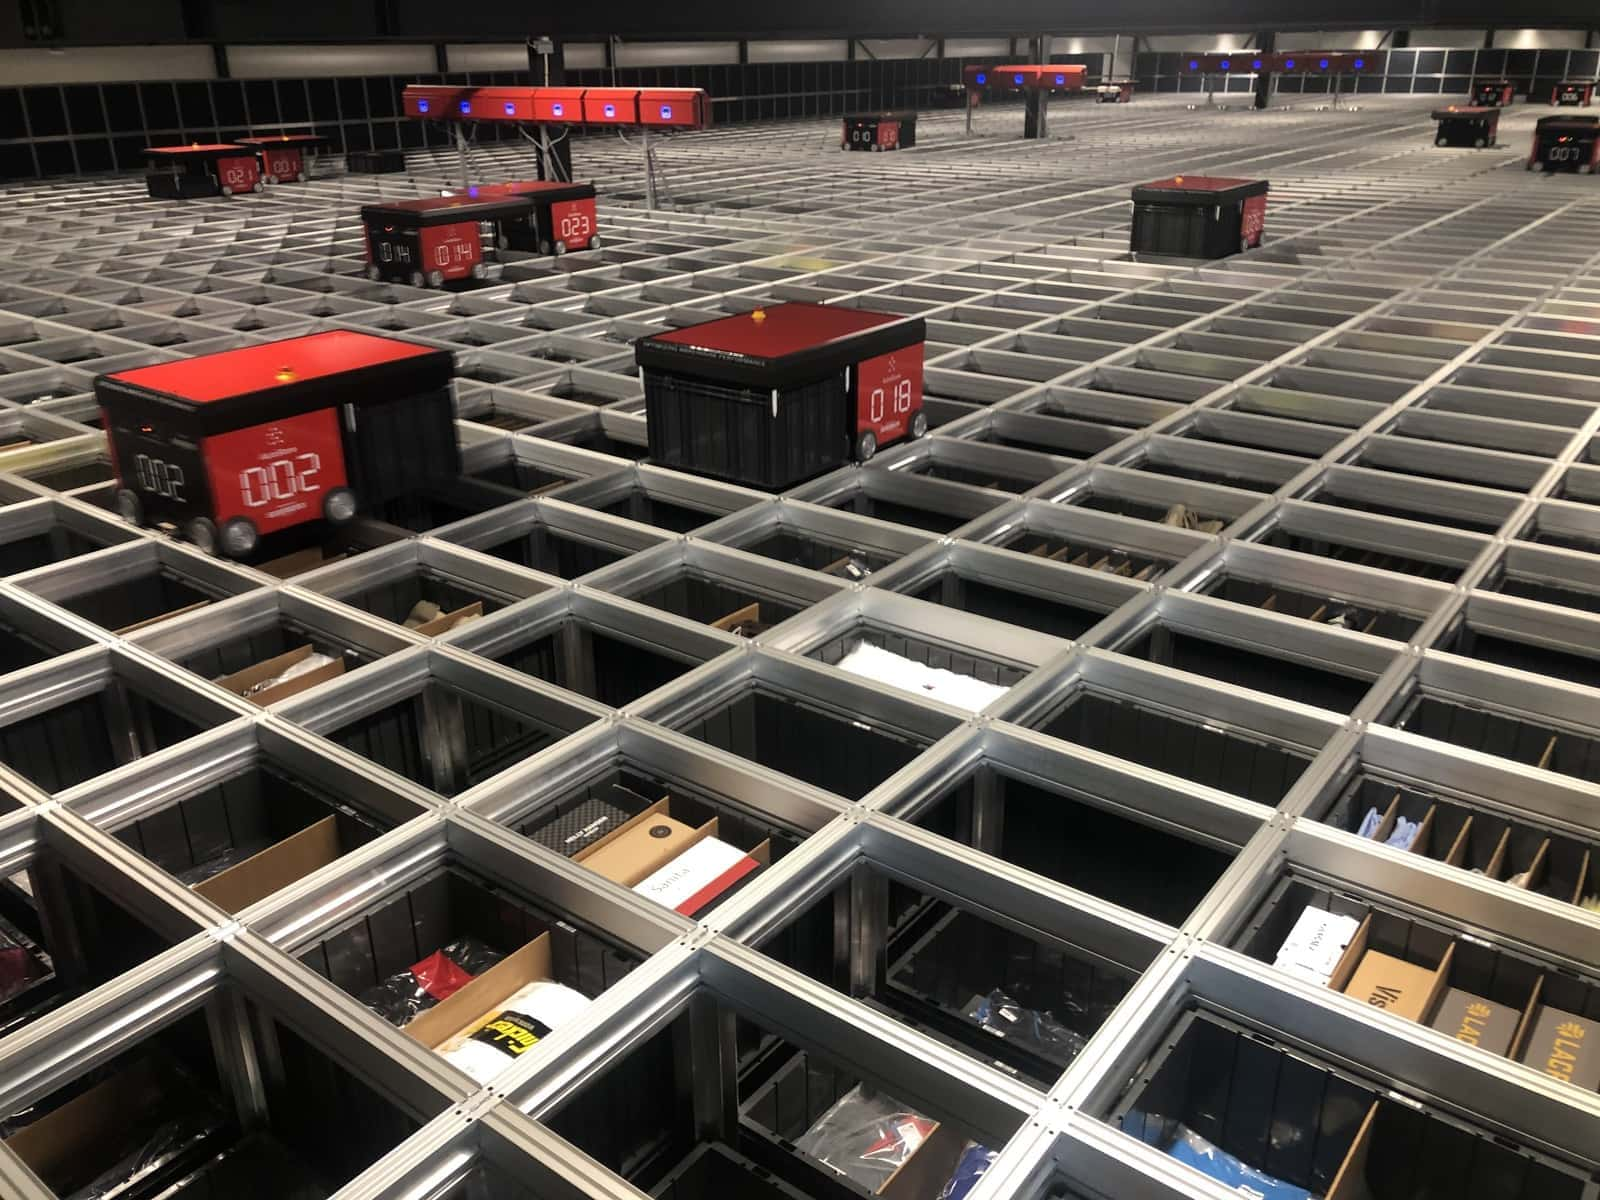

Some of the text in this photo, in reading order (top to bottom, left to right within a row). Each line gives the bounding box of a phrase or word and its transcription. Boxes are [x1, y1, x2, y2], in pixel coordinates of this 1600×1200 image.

[1550, 147, 1580, 161] 007
[226, 169, 253, 184] 021
[272, 160, 297, 173] 001
[560, 215, 590, 238] 023
[379, 242, 411, 263] 014
[434, 242, 474, 266] 014
[870, 379, 911, 423] 018
[135, 453, 187, 503] 002
[239, 452, 321, 507] 002
[650, 866, 691, 893] Sanita
